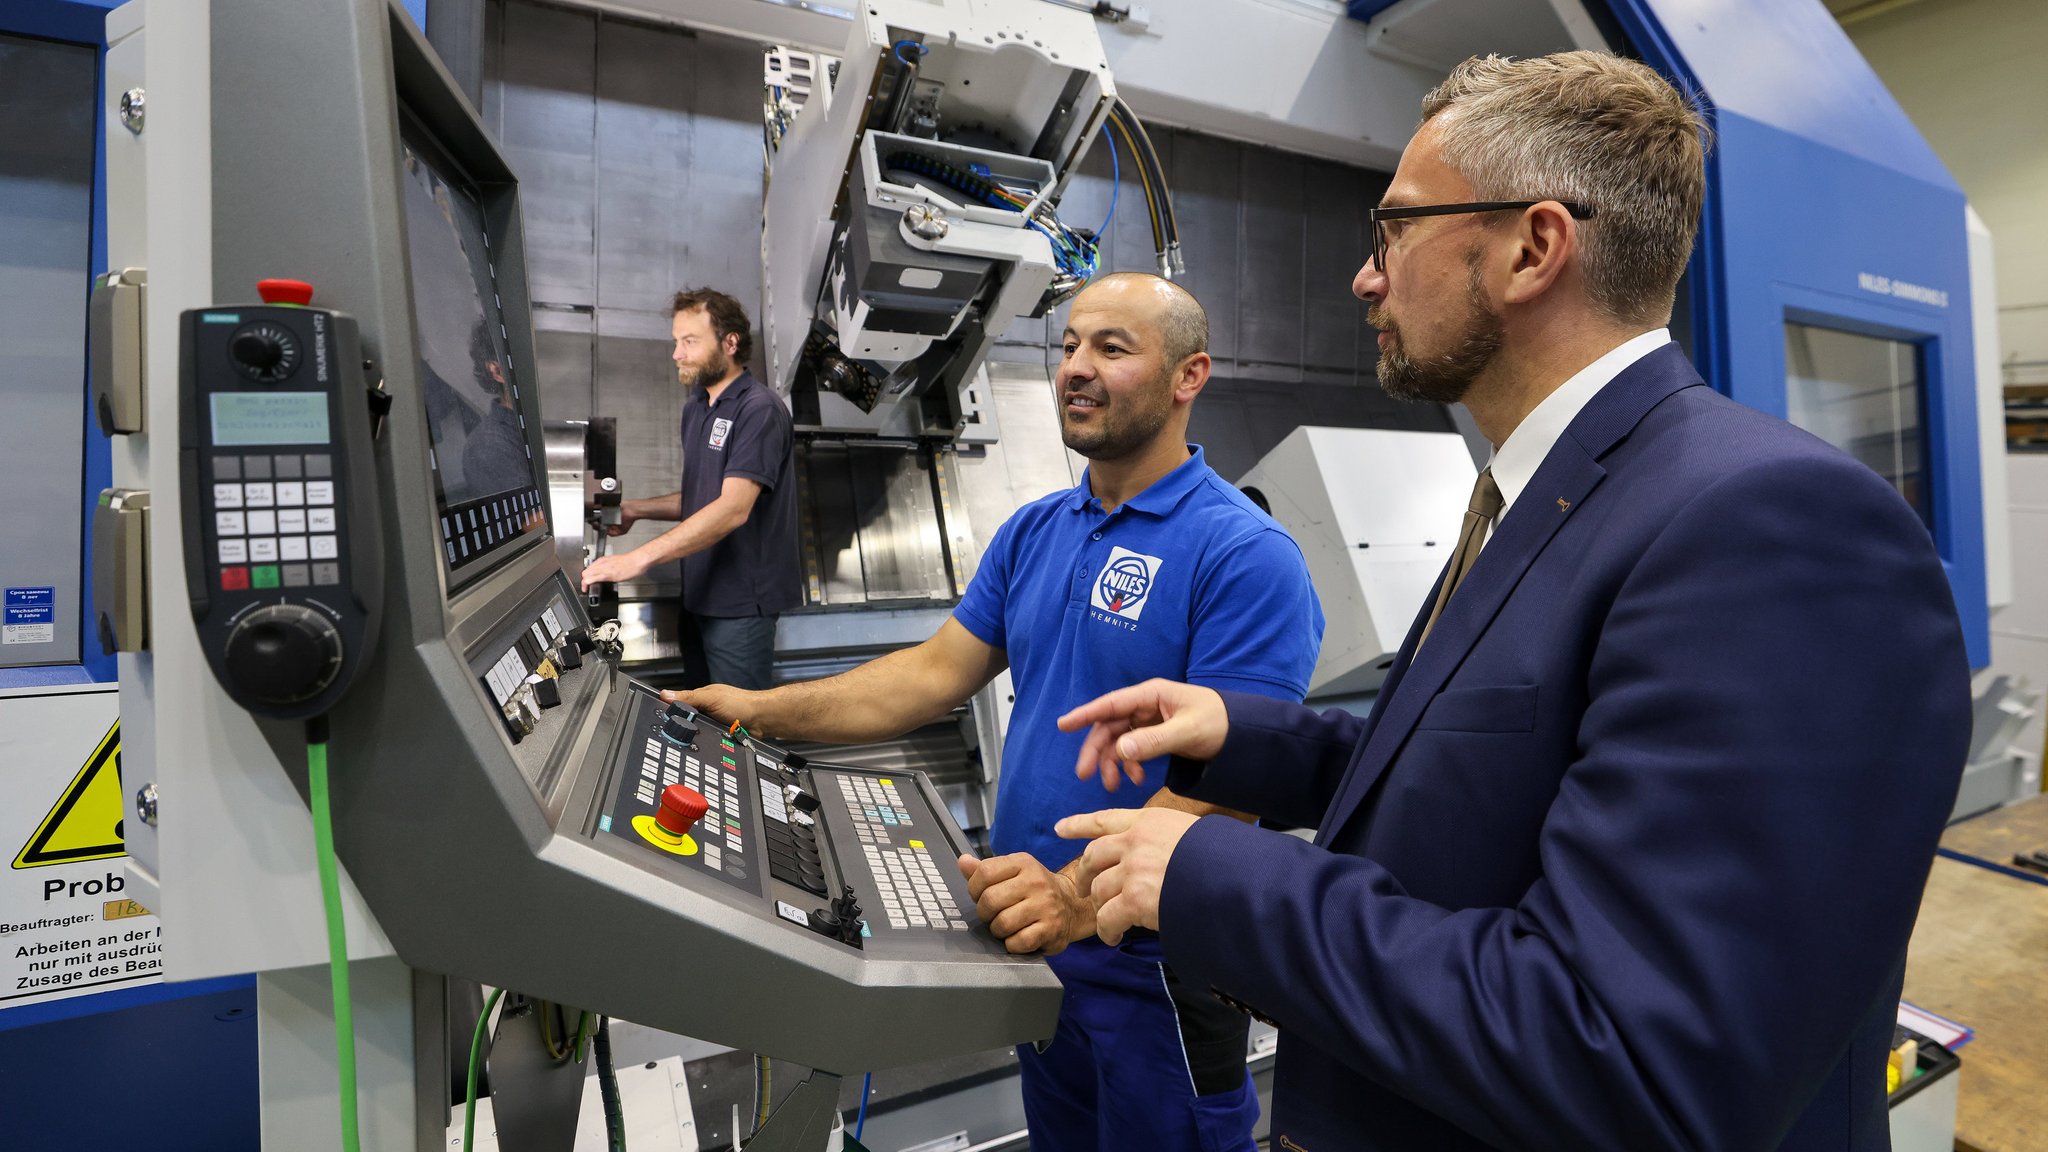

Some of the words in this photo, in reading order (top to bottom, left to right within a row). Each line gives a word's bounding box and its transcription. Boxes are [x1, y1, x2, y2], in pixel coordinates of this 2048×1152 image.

[1103, 569, 1147, 596] NILES
[0, 914, 94, 934] Beauftragter:
[15, 939, 91, 958] Arbeiten
[97, 935, 118, 946] an
[123, 930, 151, 942] der
[29, 959, 59, 972] nur
[64, 952, 92, 966] mit
[16, 971, 83, 989] Zusage
[89, 966, 119, 978] des
